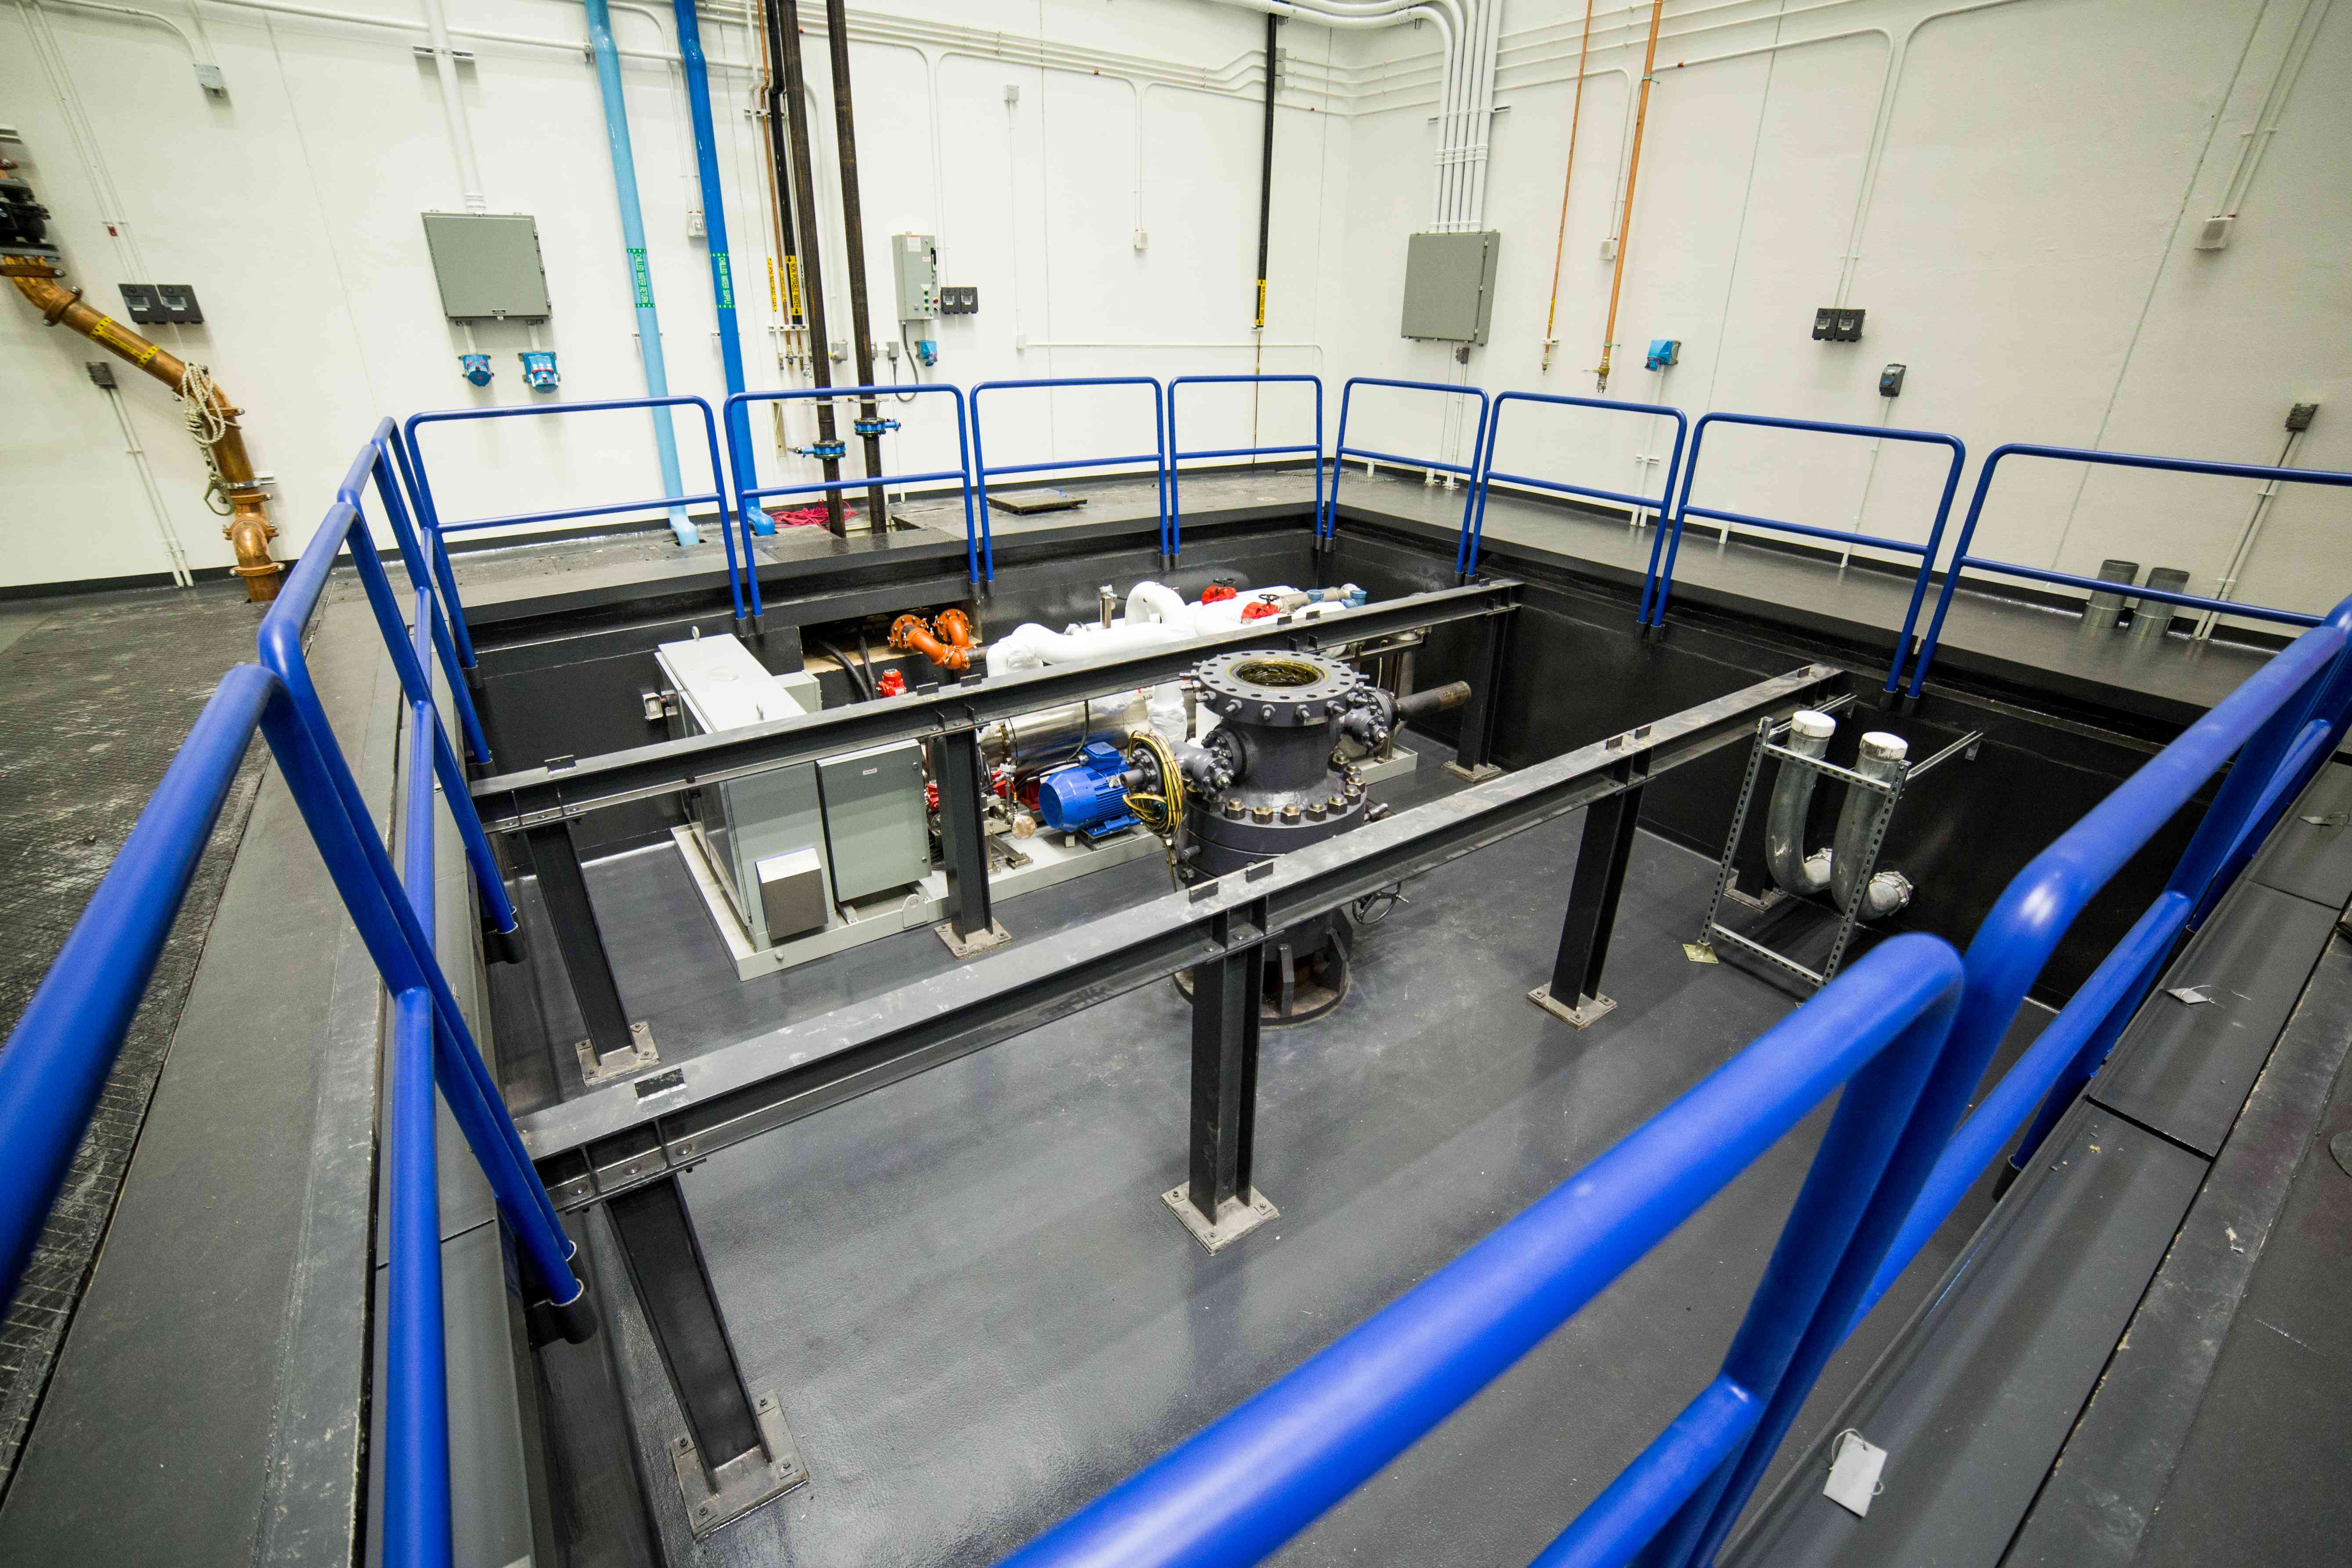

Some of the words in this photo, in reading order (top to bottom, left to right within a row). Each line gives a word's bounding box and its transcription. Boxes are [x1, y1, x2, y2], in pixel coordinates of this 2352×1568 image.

[634, 253, 644, 271] CHILLED
[719, 257, 728, 274] CHILLED
[637, 272, 647, 285] WATER
[639, 286, 649, 303] RETURN
